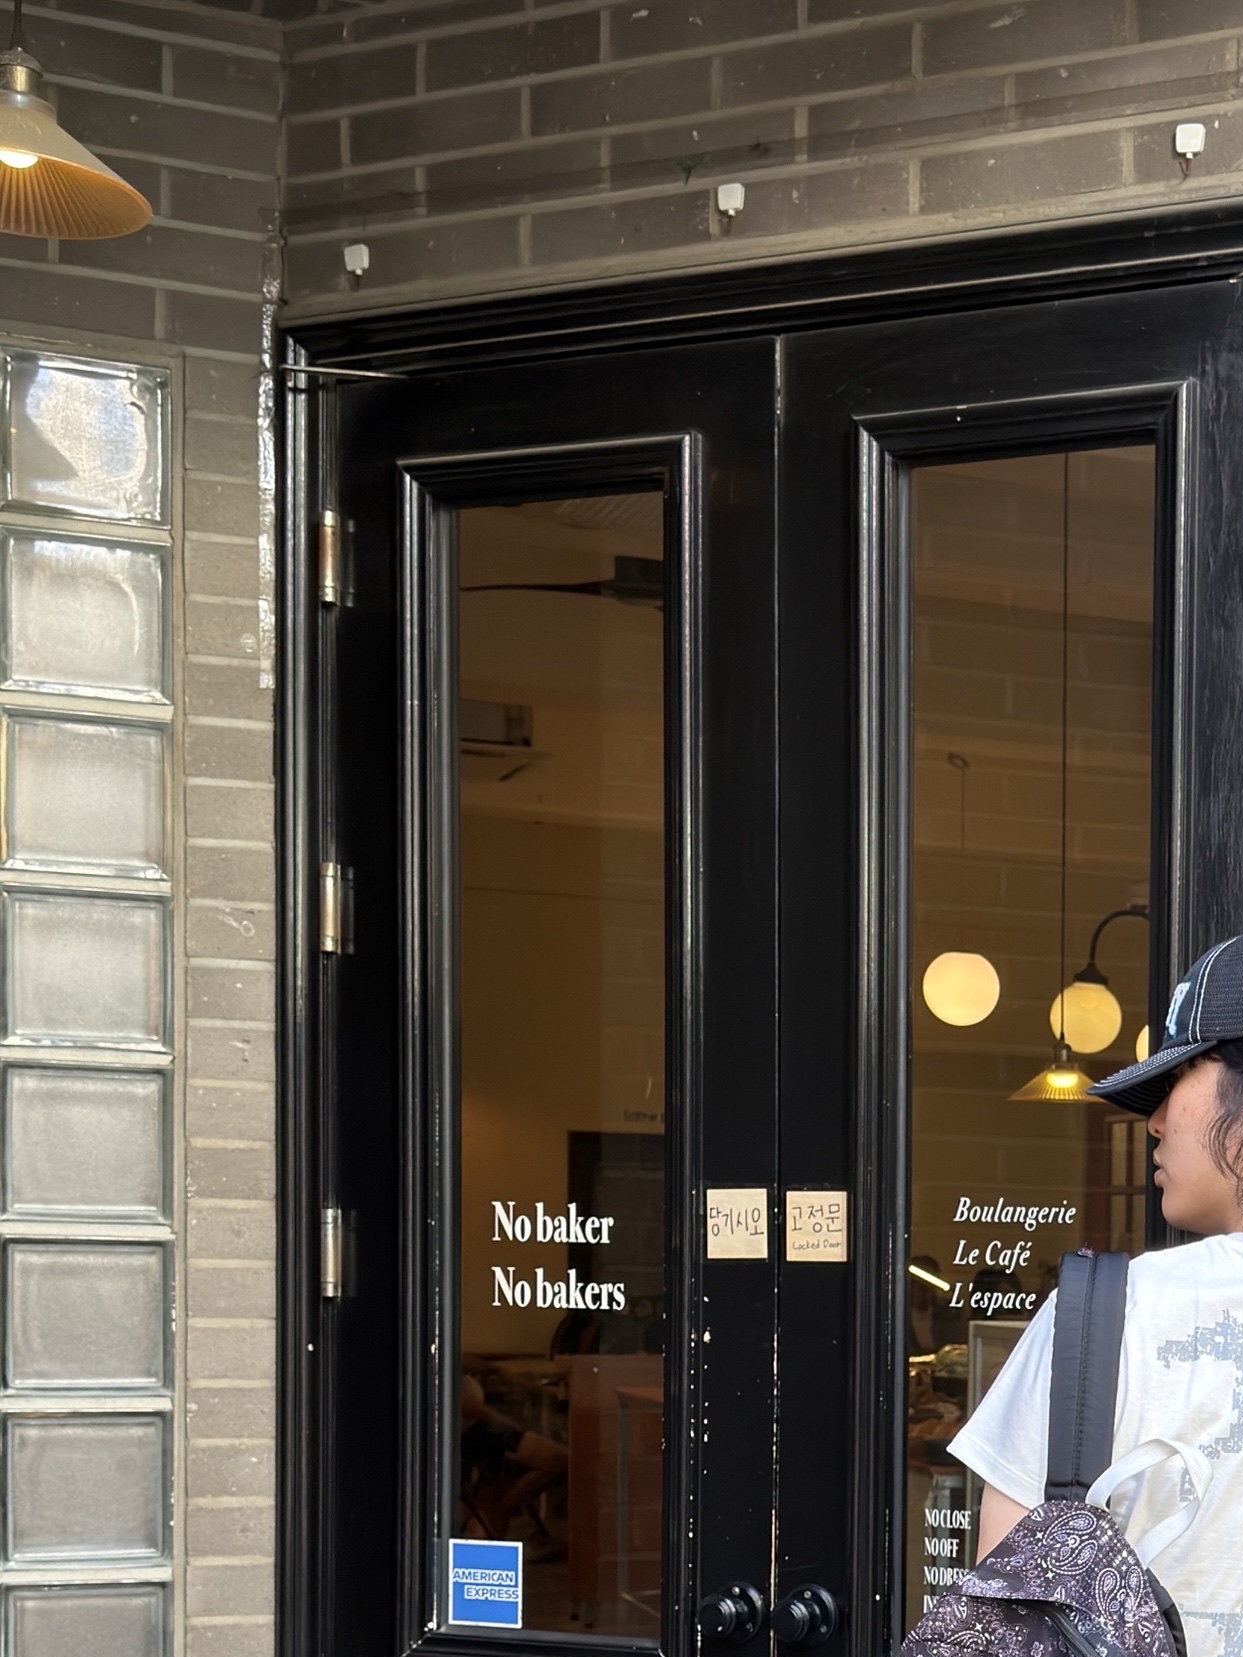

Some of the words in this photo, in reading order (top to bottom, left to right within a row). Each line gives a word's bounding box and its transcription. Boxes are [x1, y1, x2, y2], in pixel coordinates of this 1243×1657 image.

[491, 1201, 532, 1242] No
[535, 1202, 614, 1244] baker
[709, 1207, 764, 1236] 당기시오
[791, 1203, 842, 1233] 고정문
[953, 1197, 1076, 1231] Boulangerie
[953, 1240, 980, 1265] Le
[985, 1240, 1033, 1274] Café
[491, 1266, 532, 1308] No
[535, 1267, 625, 1311] bakers
[949, 1283, 1037, 1316] L'espace
[924, 1508, 939, 1527] NO
[940, 1509, 971, 1529] CLOSE
[924, 1537, 938, 1556] NO
[939, 1538, 959, 1557] OFF
[453, 1569, 514, 1584] AMERICAN
[924, 1566, 938, 1585] NO
[465, 1586, 519, 1600] EXPRESS
